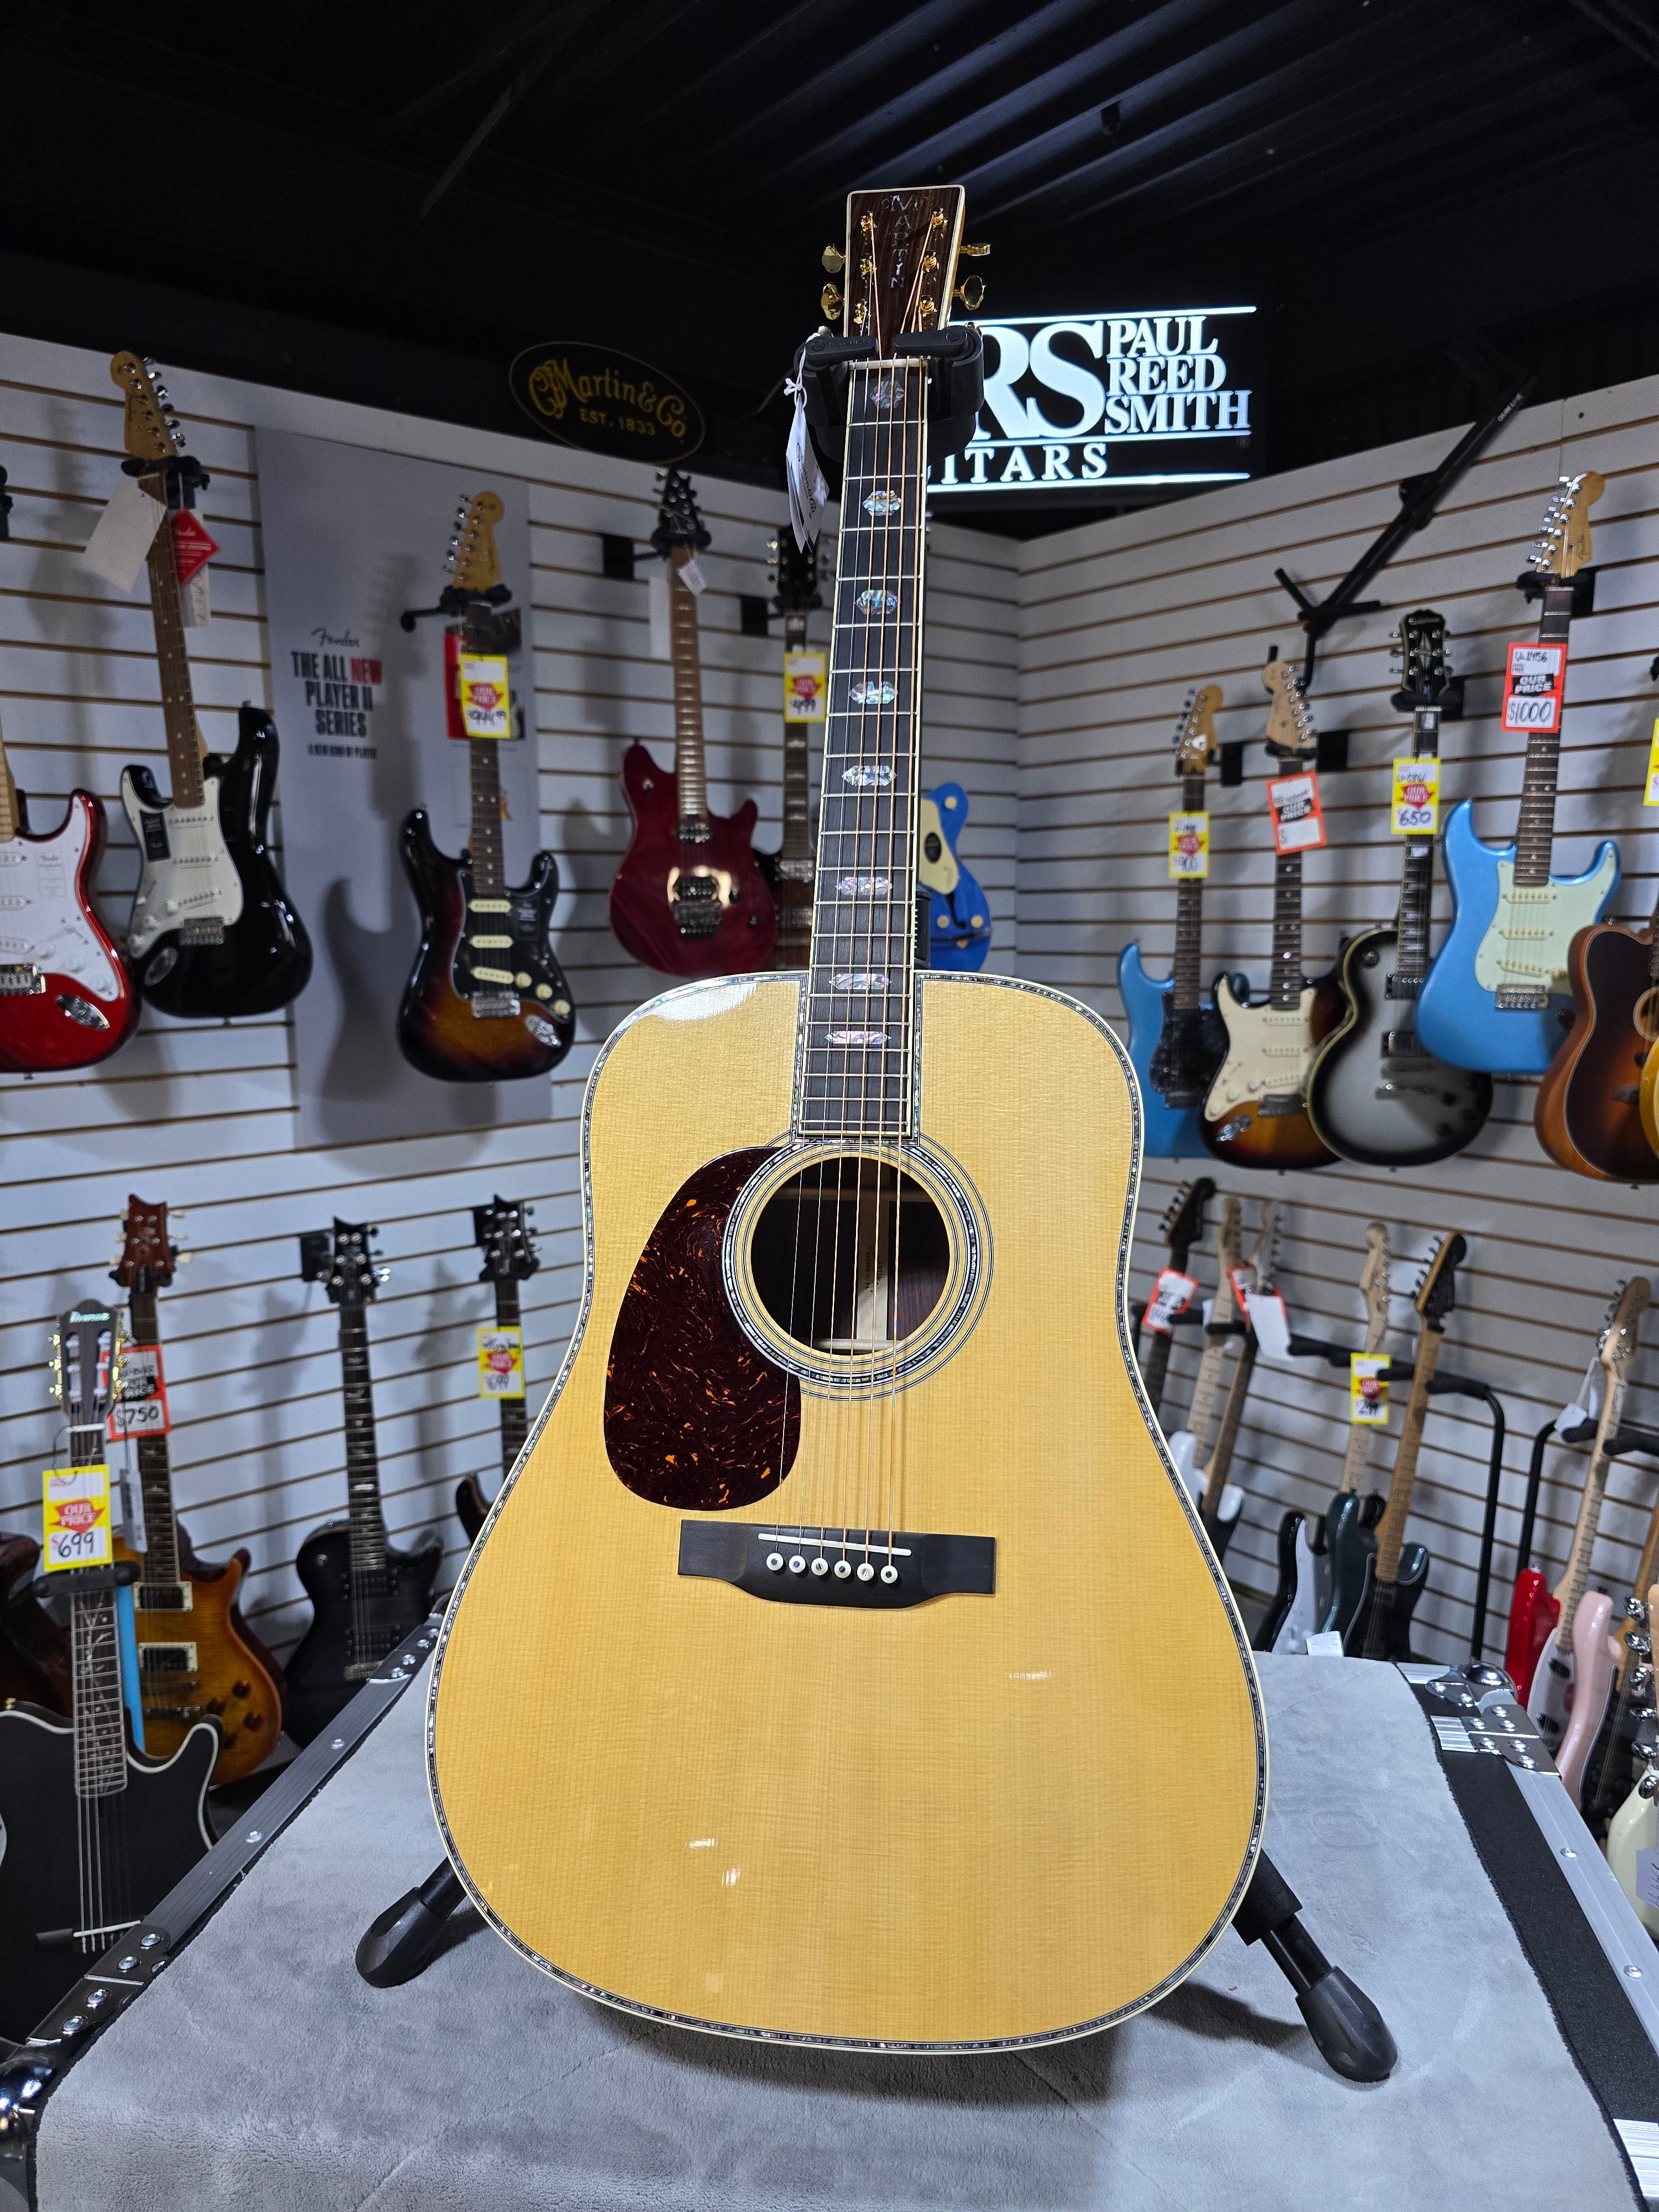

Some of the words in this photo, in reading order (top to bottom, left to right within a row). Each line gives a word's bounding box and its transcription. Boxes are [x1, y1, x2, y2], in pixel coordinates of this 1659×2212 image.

[1107, 316, 1218, 358] PAUL
[974, 321, 1104, 440] RS
[1107, 354, 1227, 396] REED
[1105, 390, 1253, 434] SMITH
[619, 417, 656, 437] 1833
[927, 443, 1107, 484] ITARS
[292, 650, 319, 680] THE
[324, 655, 348, 682] ALL
[350, 656, 383, 686] NEW
[1519, 675, 1547, 686] OUR
[305, 681, 360, 711] PLAYER
[1514, 681, 1553, 695] PRICE
[316, 709, 368, 739] SERIES
[1507, 701, 1552, 725] $1000
[116, 1405, 159, 1428] $750
[60, 1512, 97, 1527] PRICE
[64, 1503, 92, 1516] OUR
[51, 1531, 94, 1558] $699
